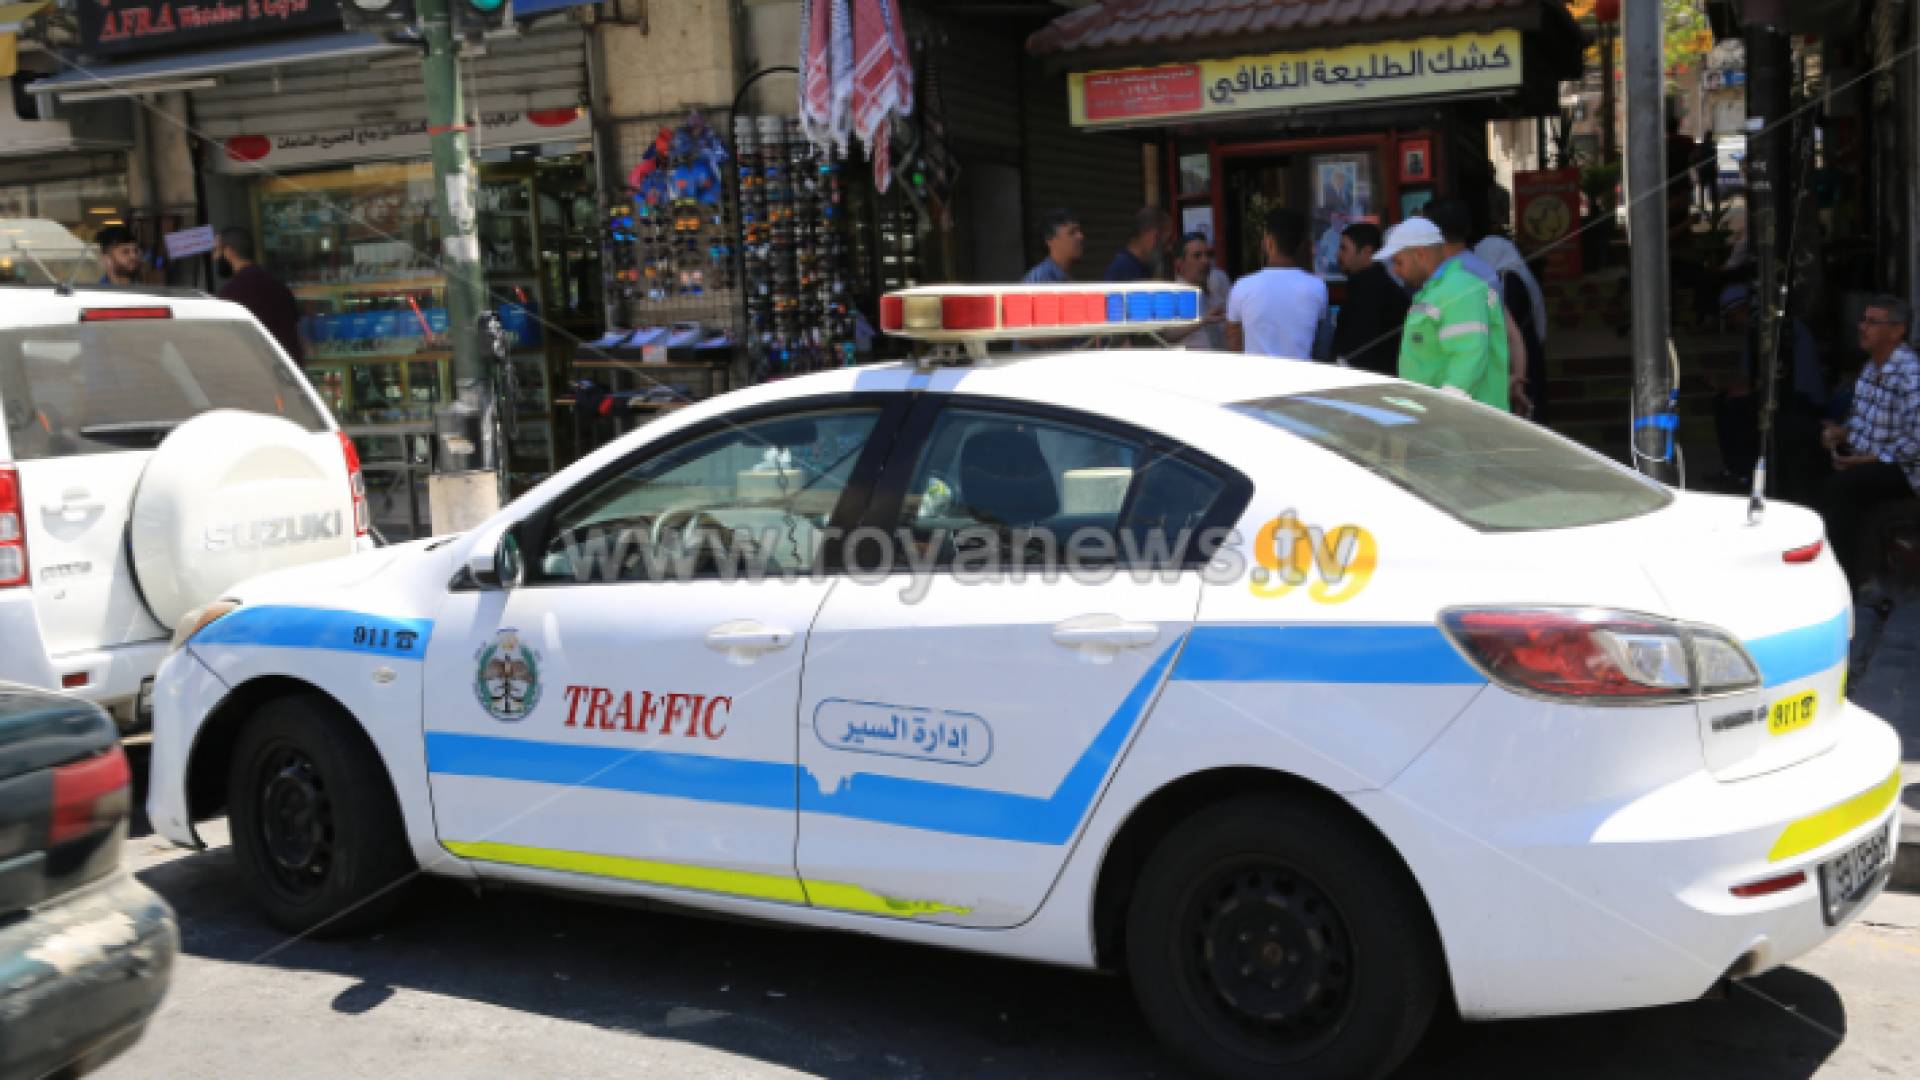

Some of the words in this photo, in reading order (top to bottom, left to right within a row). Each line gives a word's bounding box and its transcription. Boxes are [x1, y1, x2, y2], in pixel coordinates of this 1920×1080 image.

[98, 3, 176, 40] AFRA
[1312, 48, 1425, 89] الطليعة
[1428, 41, 1512, 74] كشك
[1208, 61, 1309, 104] الثقافي
[204, 509, 342, 551] SUZUKI
[1249, 516, 1378, 605] 99
[353, 625, 390, 648] 911
[563, 684, 733, 741] TRAFFIC
[839, 713, 909, 744] السير
[911, 716, 969, 757] إدارة
